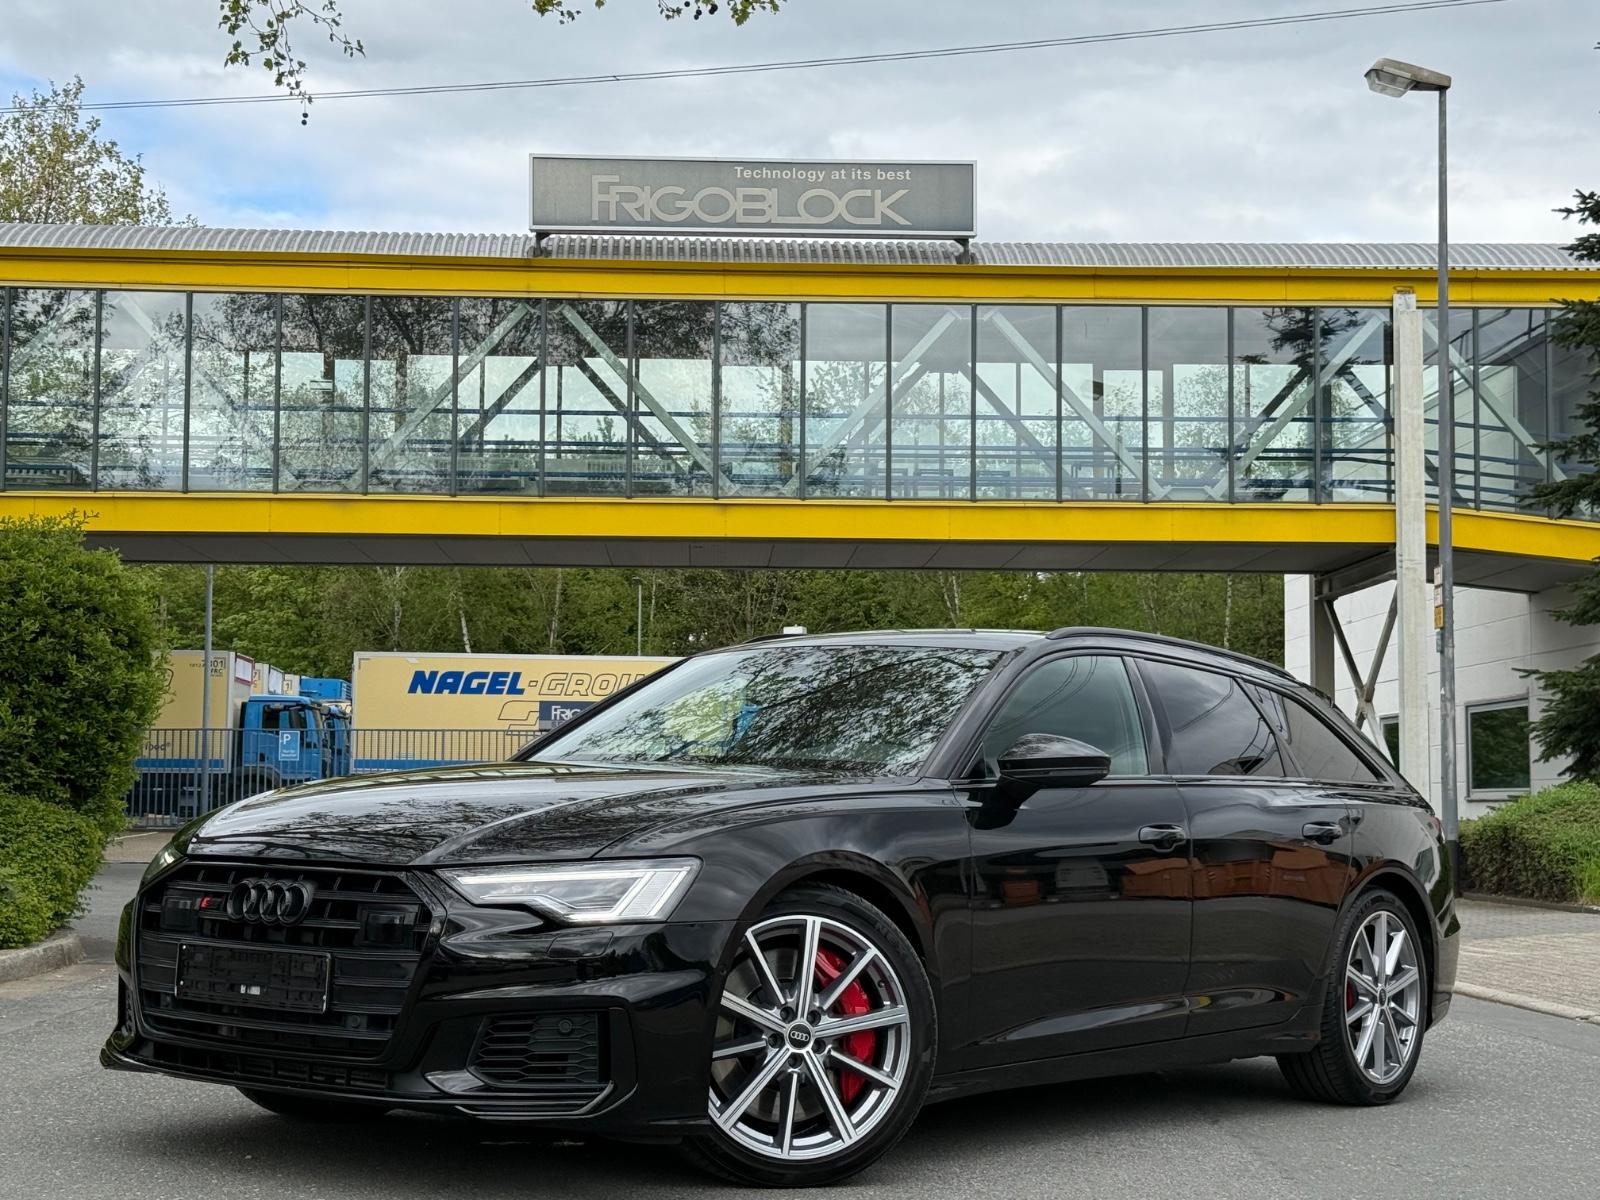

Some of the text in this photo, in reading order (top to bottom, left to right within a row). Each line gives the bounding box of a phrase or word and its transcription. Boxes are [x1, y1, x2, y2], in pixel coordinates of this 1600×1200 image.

[734, 166, 911, 182] Technology at its best
[591, 174, 913, 226] FRIGOBLOCK
[283, 733, 291, 745] P
